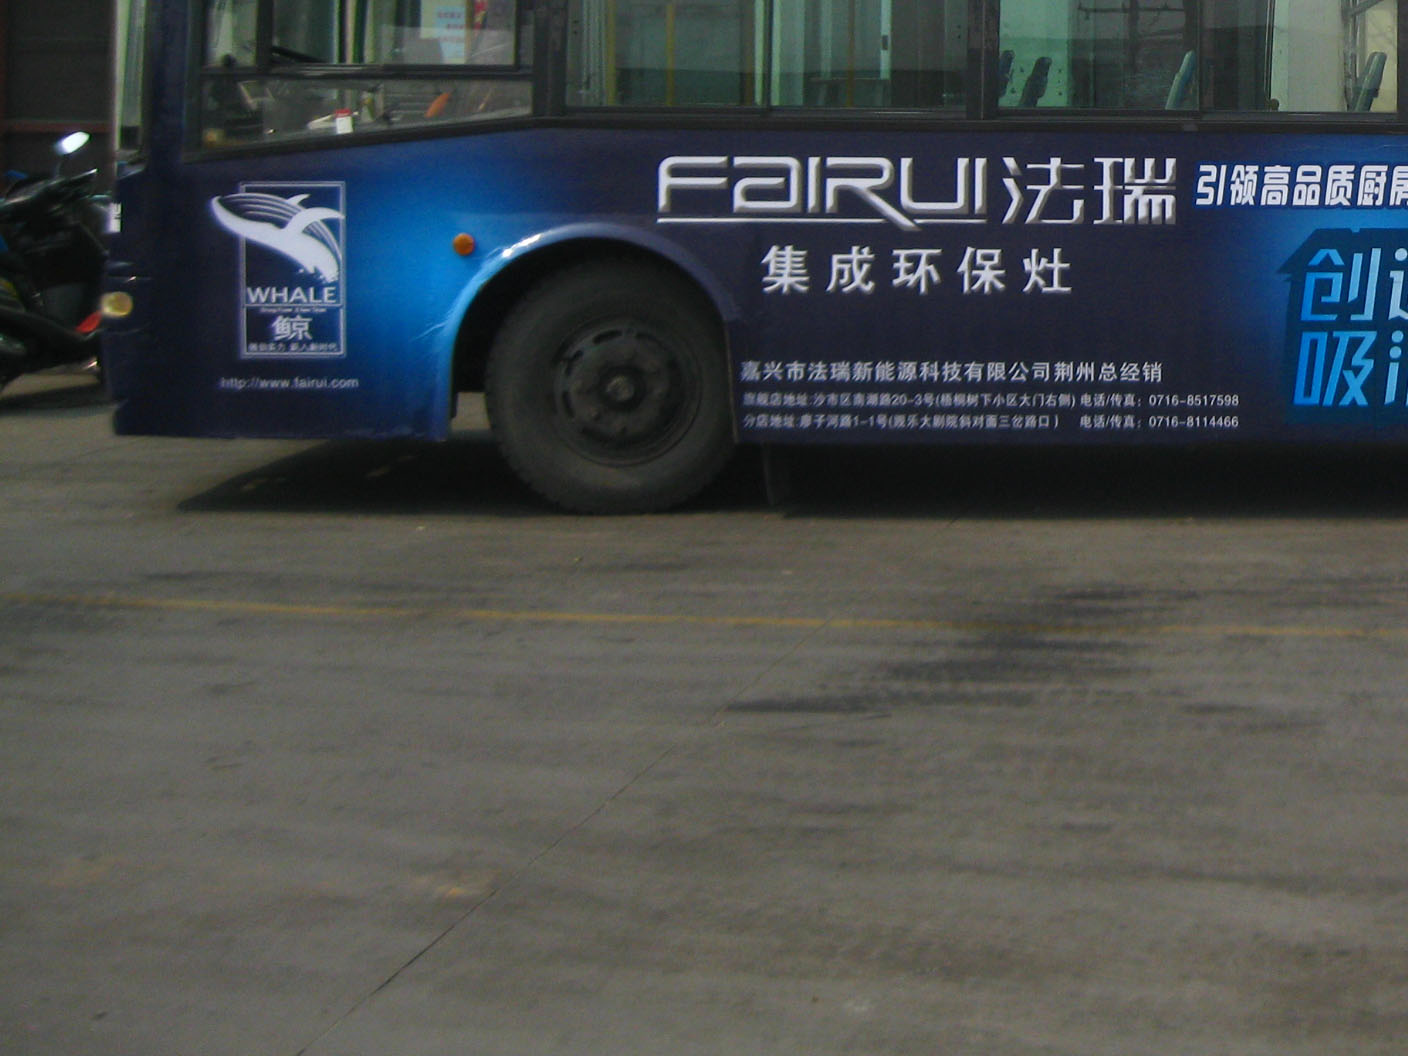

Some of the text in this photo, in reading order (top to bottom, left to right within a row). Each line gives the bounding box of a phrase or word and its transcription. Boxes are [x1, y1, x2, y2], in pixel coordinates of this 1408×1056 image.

[1001, 156, 1177, 225] 法瑞
[760, 244, 1073, 295] 集成环保灶
[246, 286, 337, 304] WHALE
[272, 315, 313, 341] 鲸
[220, 377, 359, 390] http://www.fairui.com
[741, 360, 1164, 384] 嘉兴市法瑞新能源科技有限公司荆州总经销
